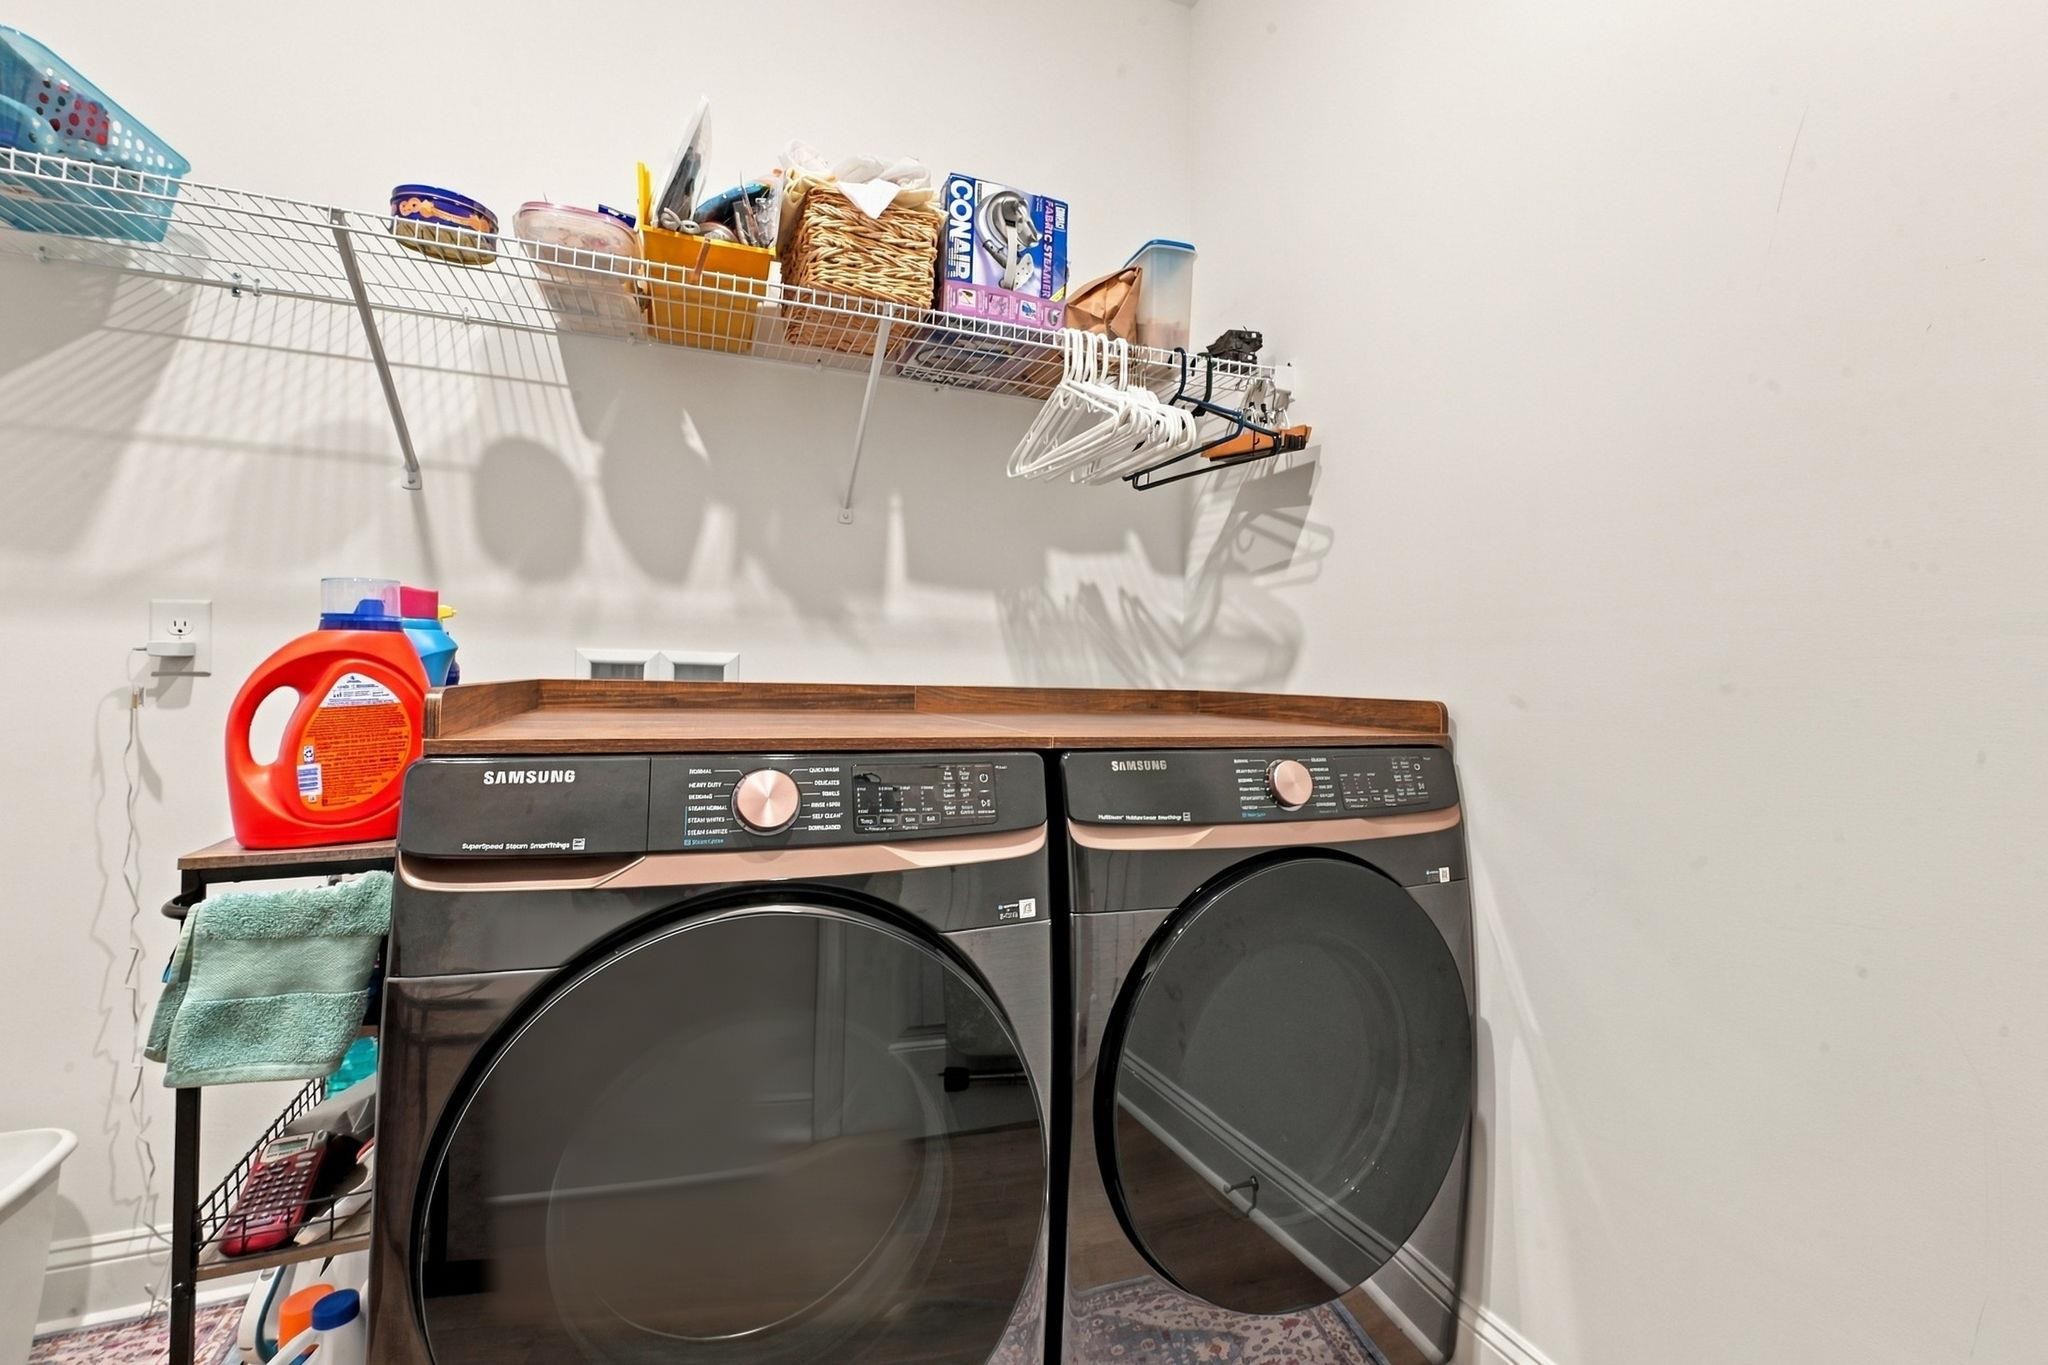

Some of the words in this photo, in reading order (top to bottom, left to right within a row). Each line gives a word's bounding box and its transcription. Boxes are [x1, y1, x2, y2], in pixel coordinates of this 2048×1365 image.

[948, 179, 973, 279] CONAIR
[1044, 199, 1054, 242] FABRIC
[1042, 244, 1053, 299] STEAMER
[483, 770, 576, 785] SAMSUNG
[1111, 760, 1167, 771] SAMSUNG
[462, 843, 504, 851] SuperSpeed
[530, 842, 570, 850] SmartThings
